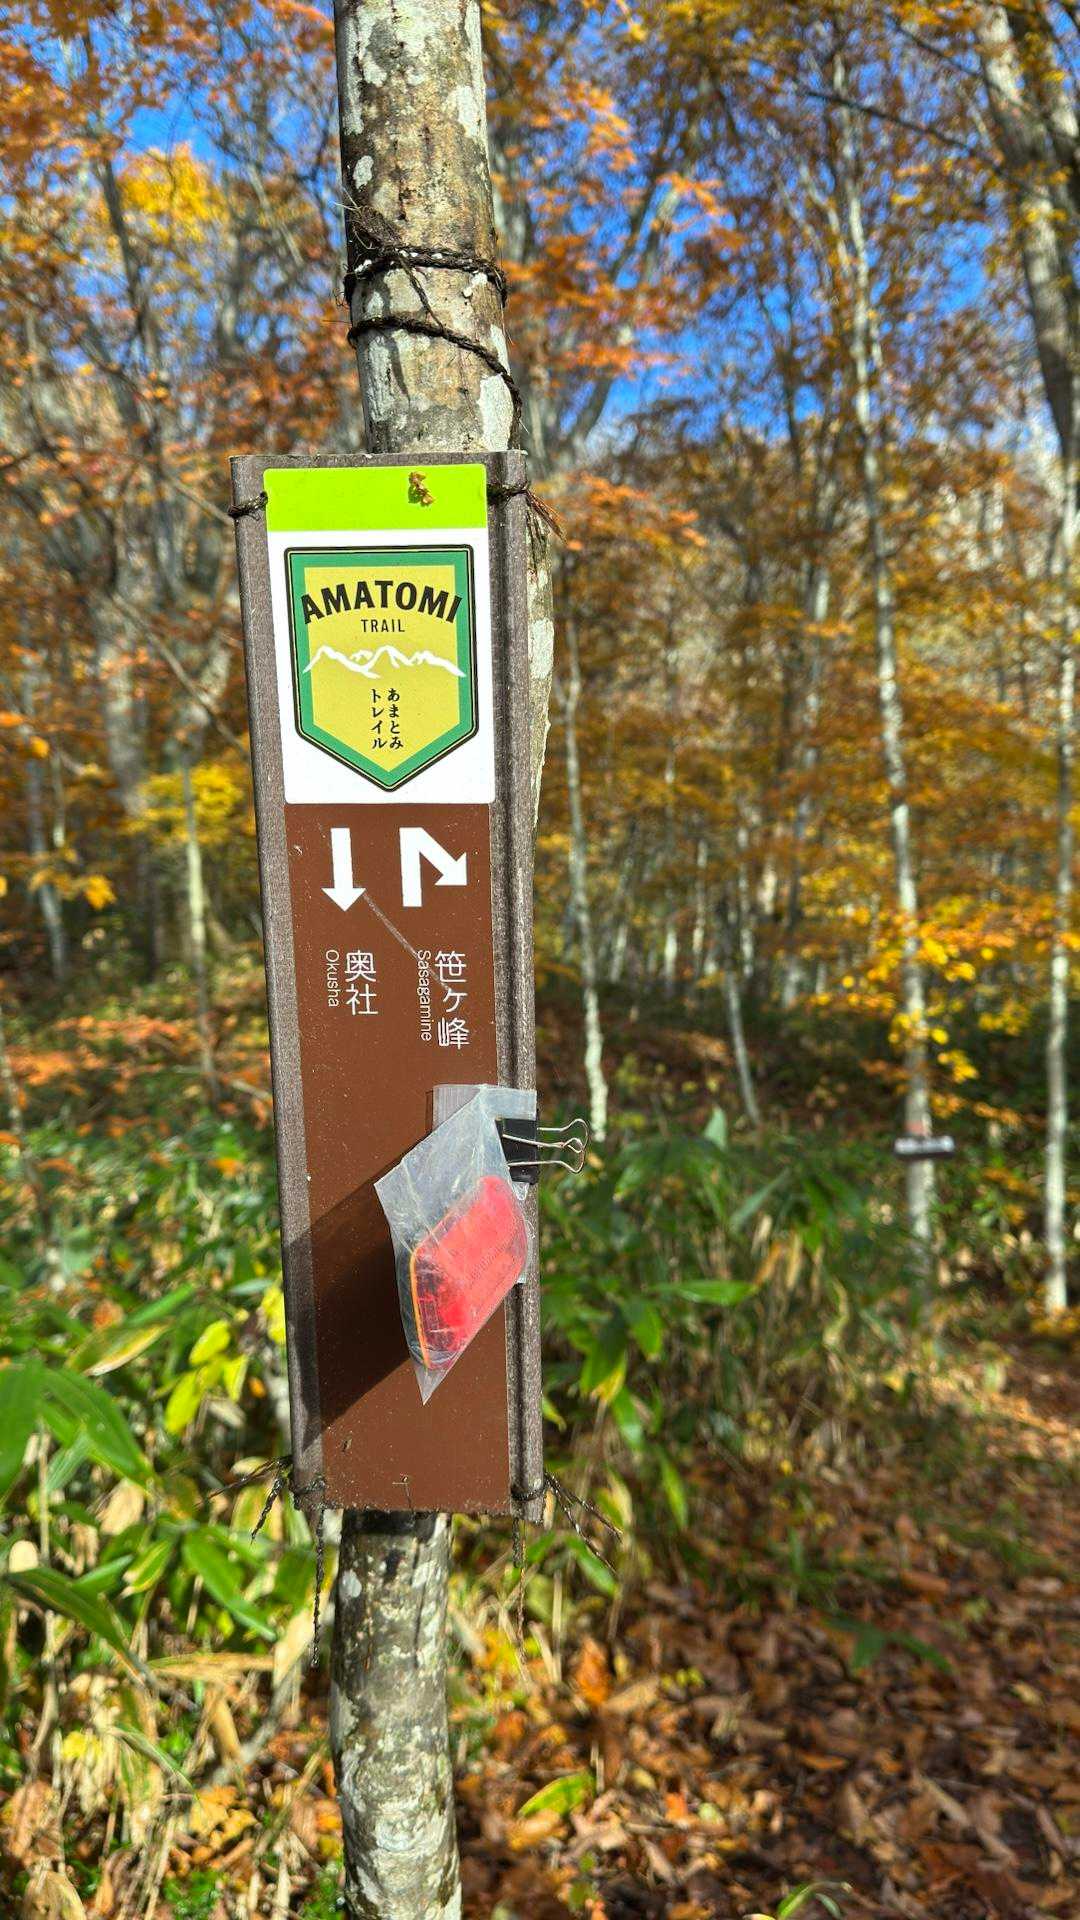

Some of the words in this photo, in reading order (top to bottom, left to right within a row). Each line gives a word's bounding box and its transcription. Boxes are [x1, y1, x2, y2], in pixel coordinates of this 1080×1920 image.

[301, 580, 463, 624] AMATOMI
[361, 619, 406, 633] TRAIL
[371, 688, 387, 749] トレイル
[388, 688, 404, 750] あまとみ
[325, 949, 342, 1007] Okusha
[344, 950, 379, 1016] 奥社
[417, 949, 434, 1041] Sasagamine
